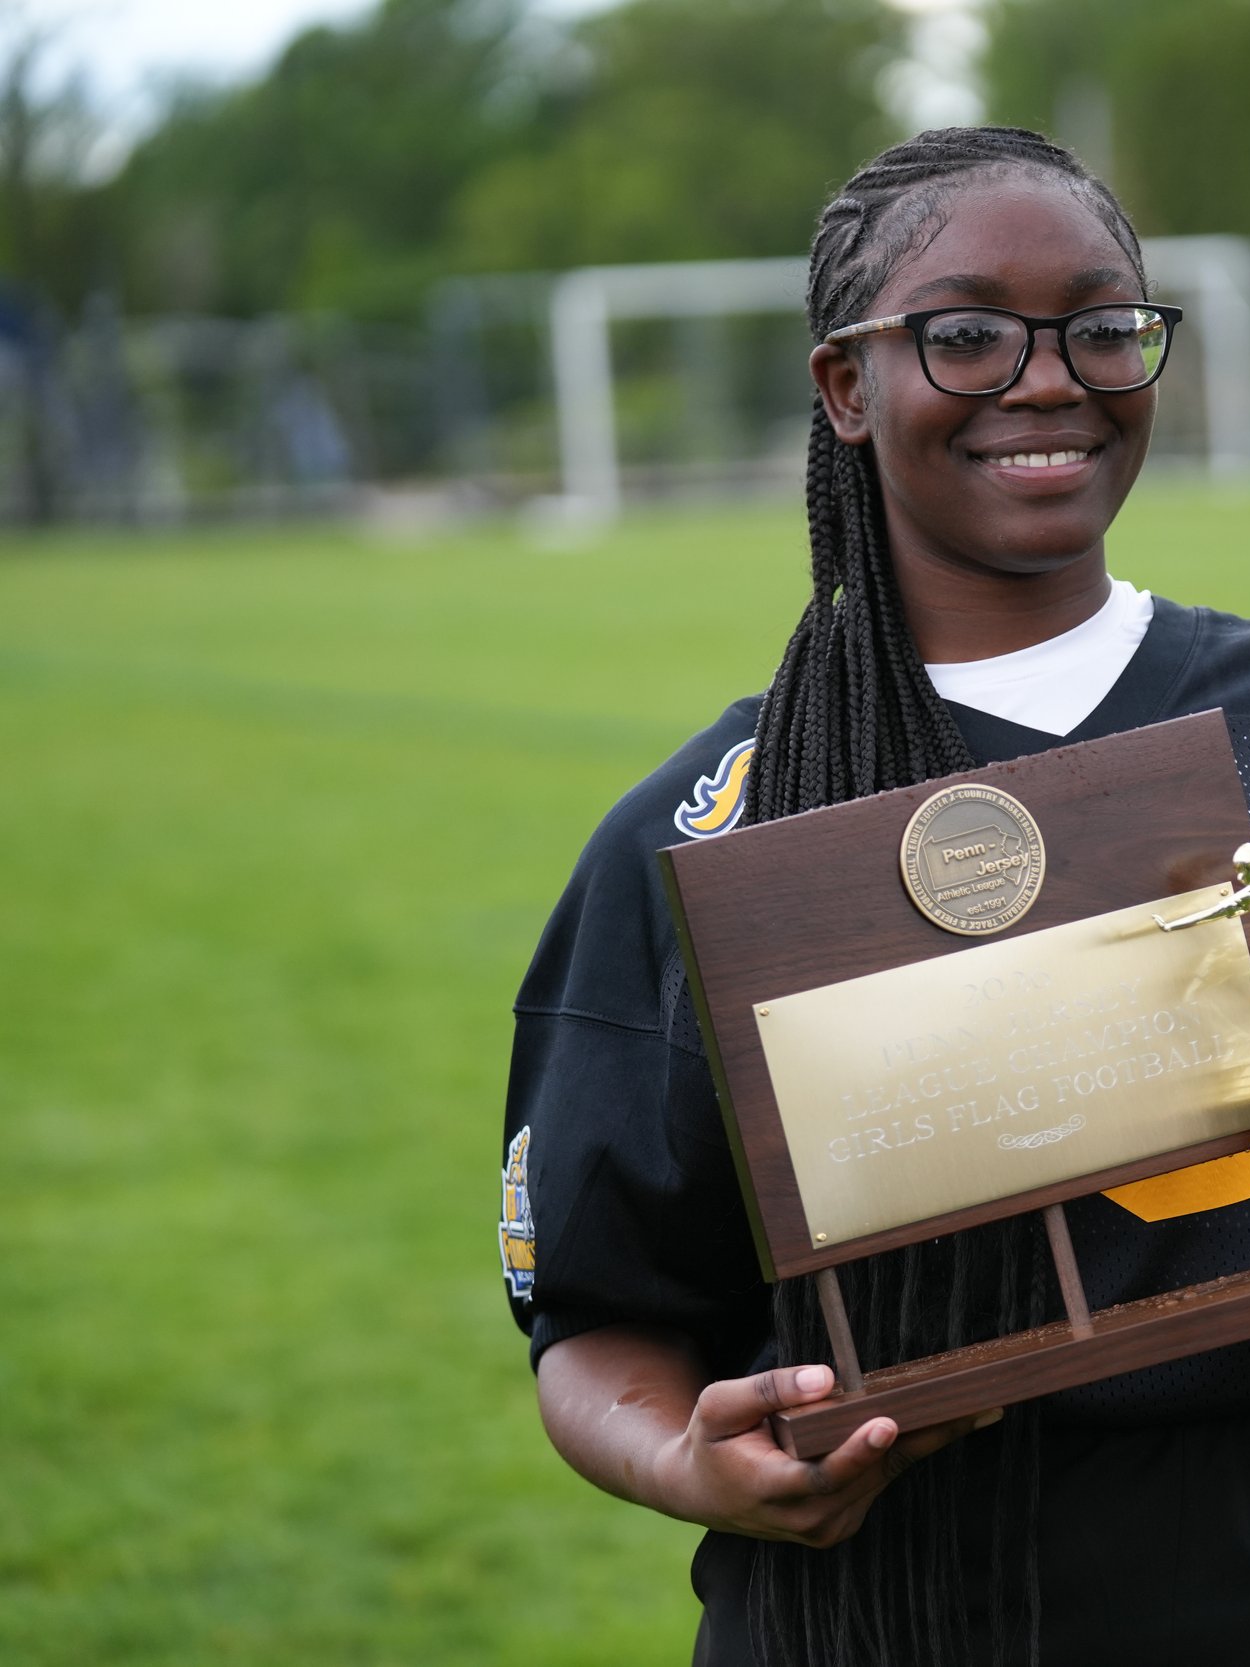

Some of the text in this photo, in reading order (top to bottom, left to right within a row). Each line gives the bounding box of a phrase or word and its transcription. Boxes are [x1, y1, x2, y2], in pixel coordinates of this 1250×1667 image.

[949, 789, 998, 802] X-COUNTRY
[919, 797, 949, 824] SOCCER
[999, 797, 1037, 842] BASKETBALL
[907, 824, 923, 855] TENNIS
[942, 843, 986, 864] Penn
[976, 852, 1029, 876] Jersey
[1028, 844, 1041, 888] SOFTBALL
[907, 858, 935, 910] VOLLEYBALL
[937, 877, 1006, 902] Athletic League
[934, 909, 959, 926] FIELD
[998, 889, 1032, 923] BASEBALL
[968, 918, 998, 930] TRACK
[842, 1001, 1201, 1121] LEAGUE CHAMPION
[829, 1034, 1235, 1163] GIRLS FLAG FOOTBALL
